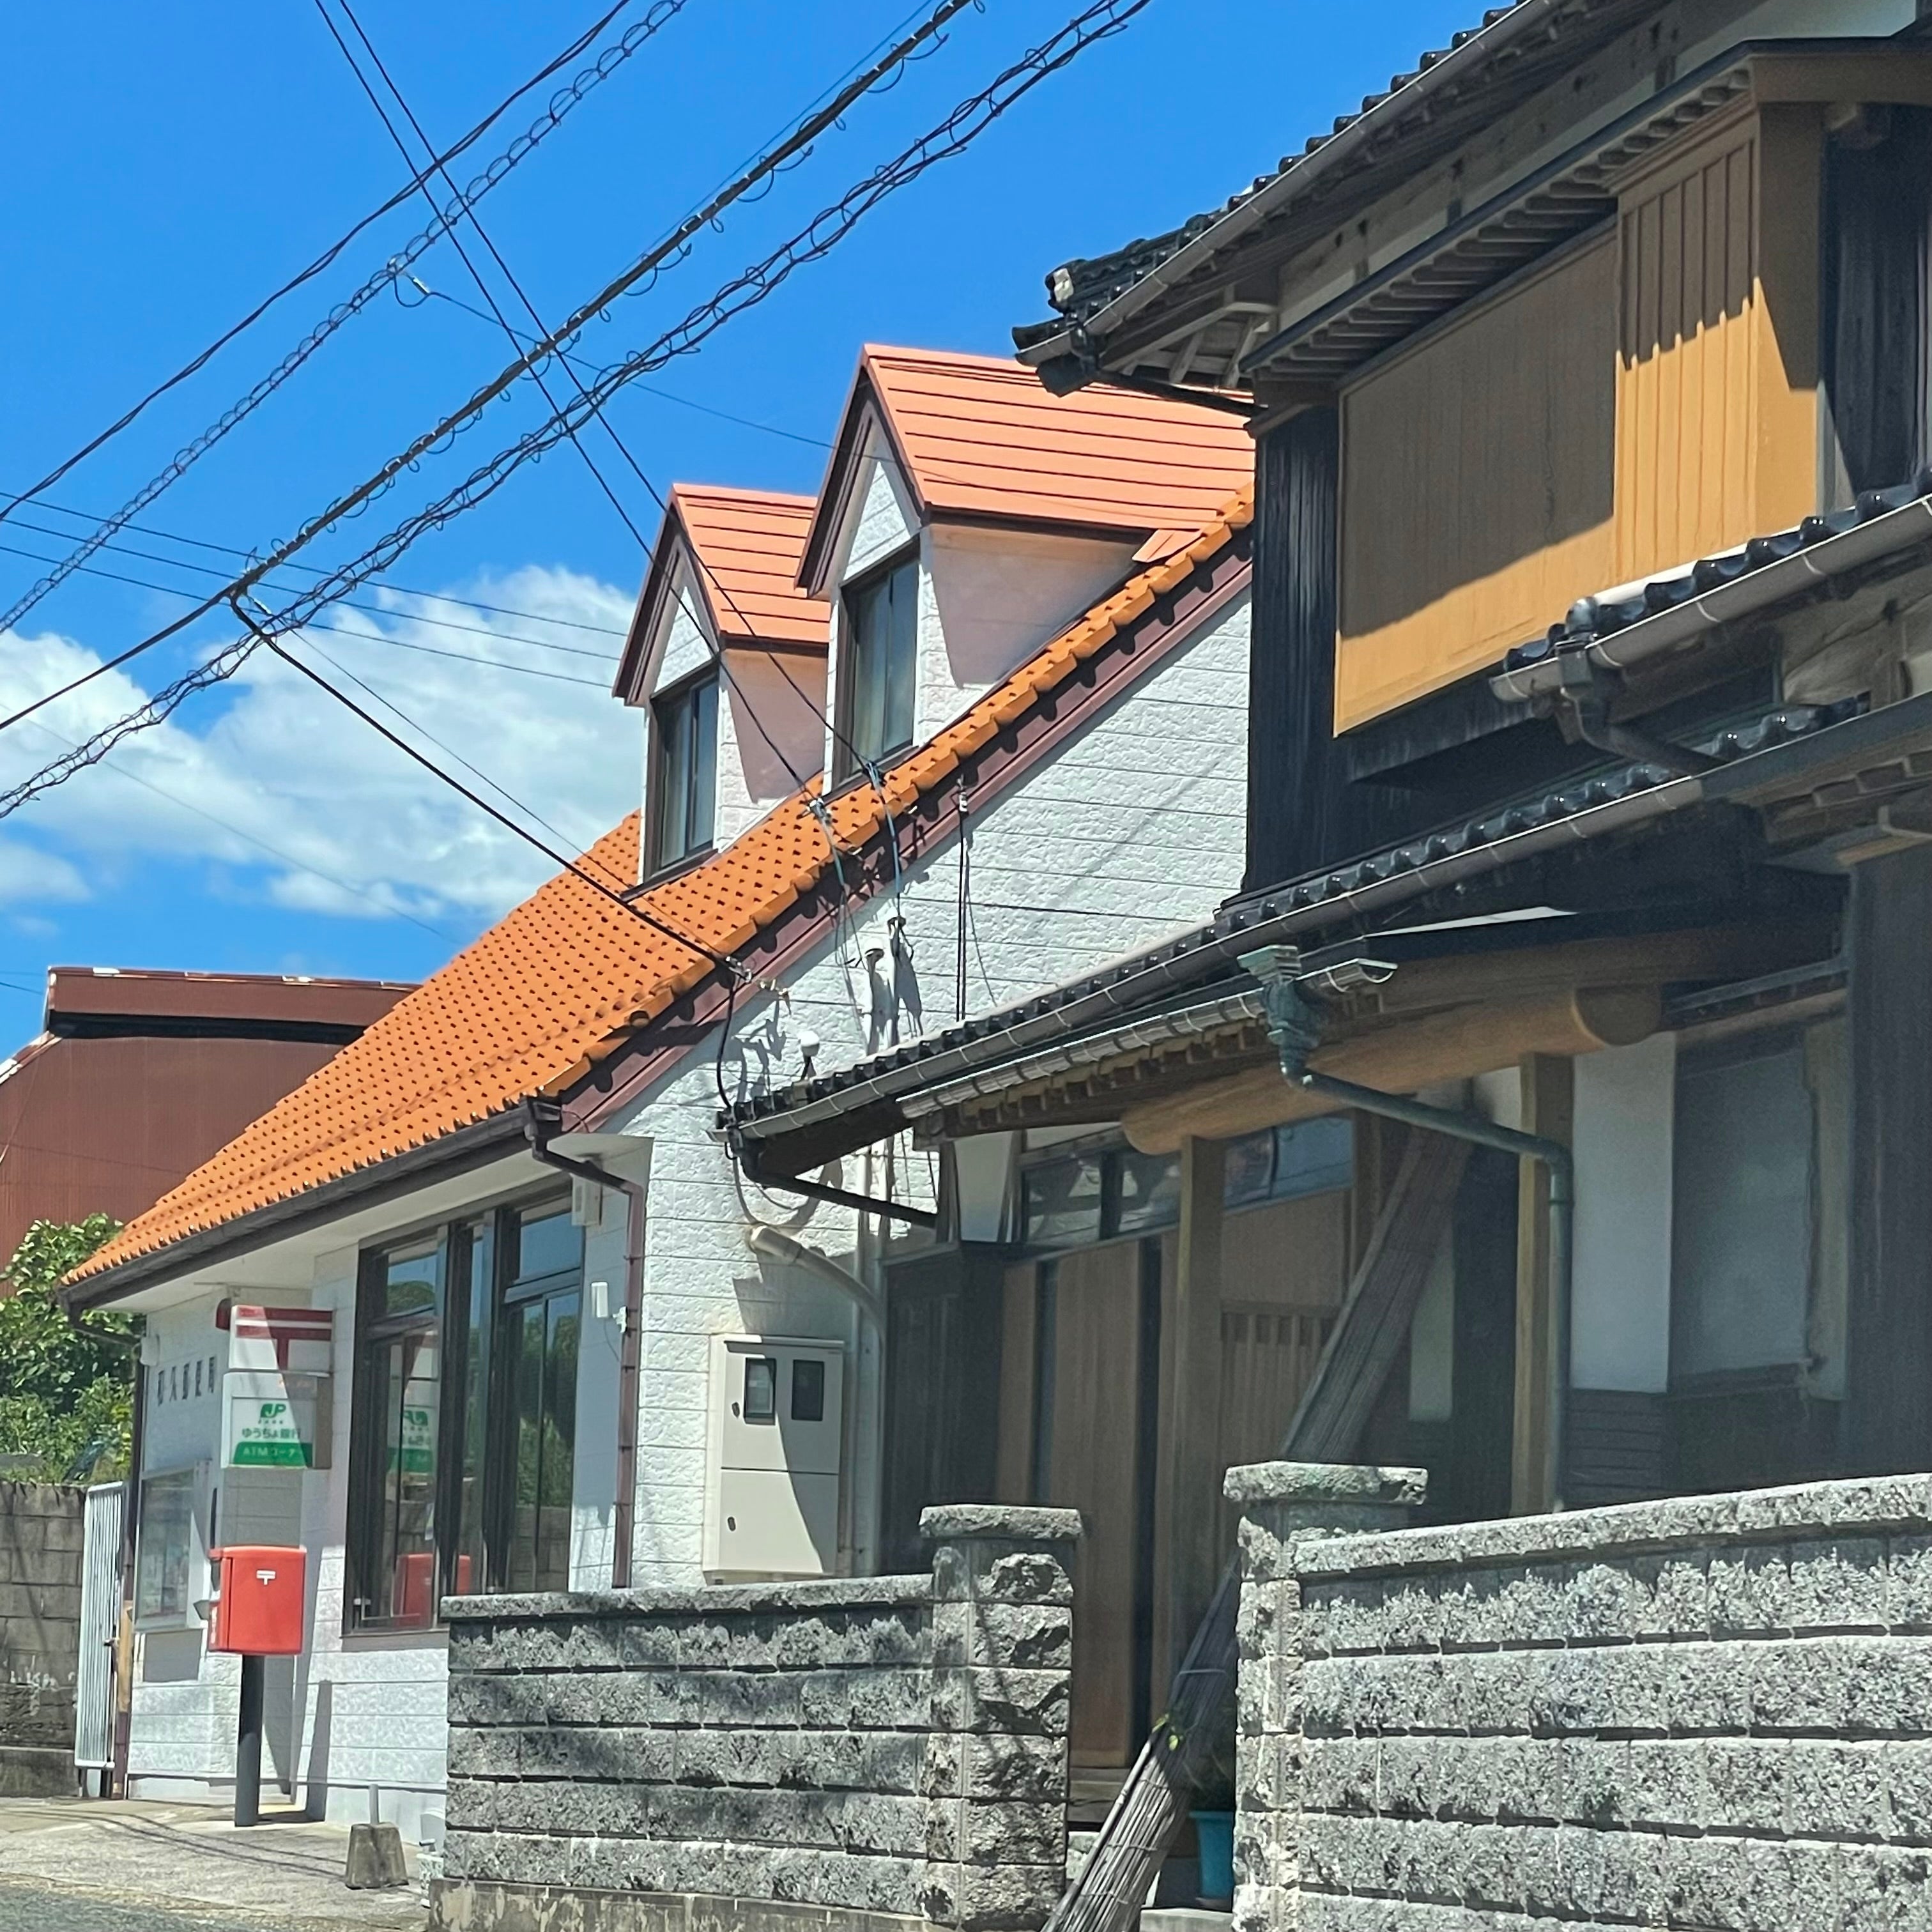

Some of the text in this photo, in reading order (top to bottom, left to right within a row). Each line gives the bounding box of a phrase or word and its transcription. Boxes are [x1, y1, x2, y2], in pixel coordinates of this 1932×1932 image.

[260, 1403, 286, 1418] JP
[242, 1428, 301, 1439] ゆうちょ銀行
